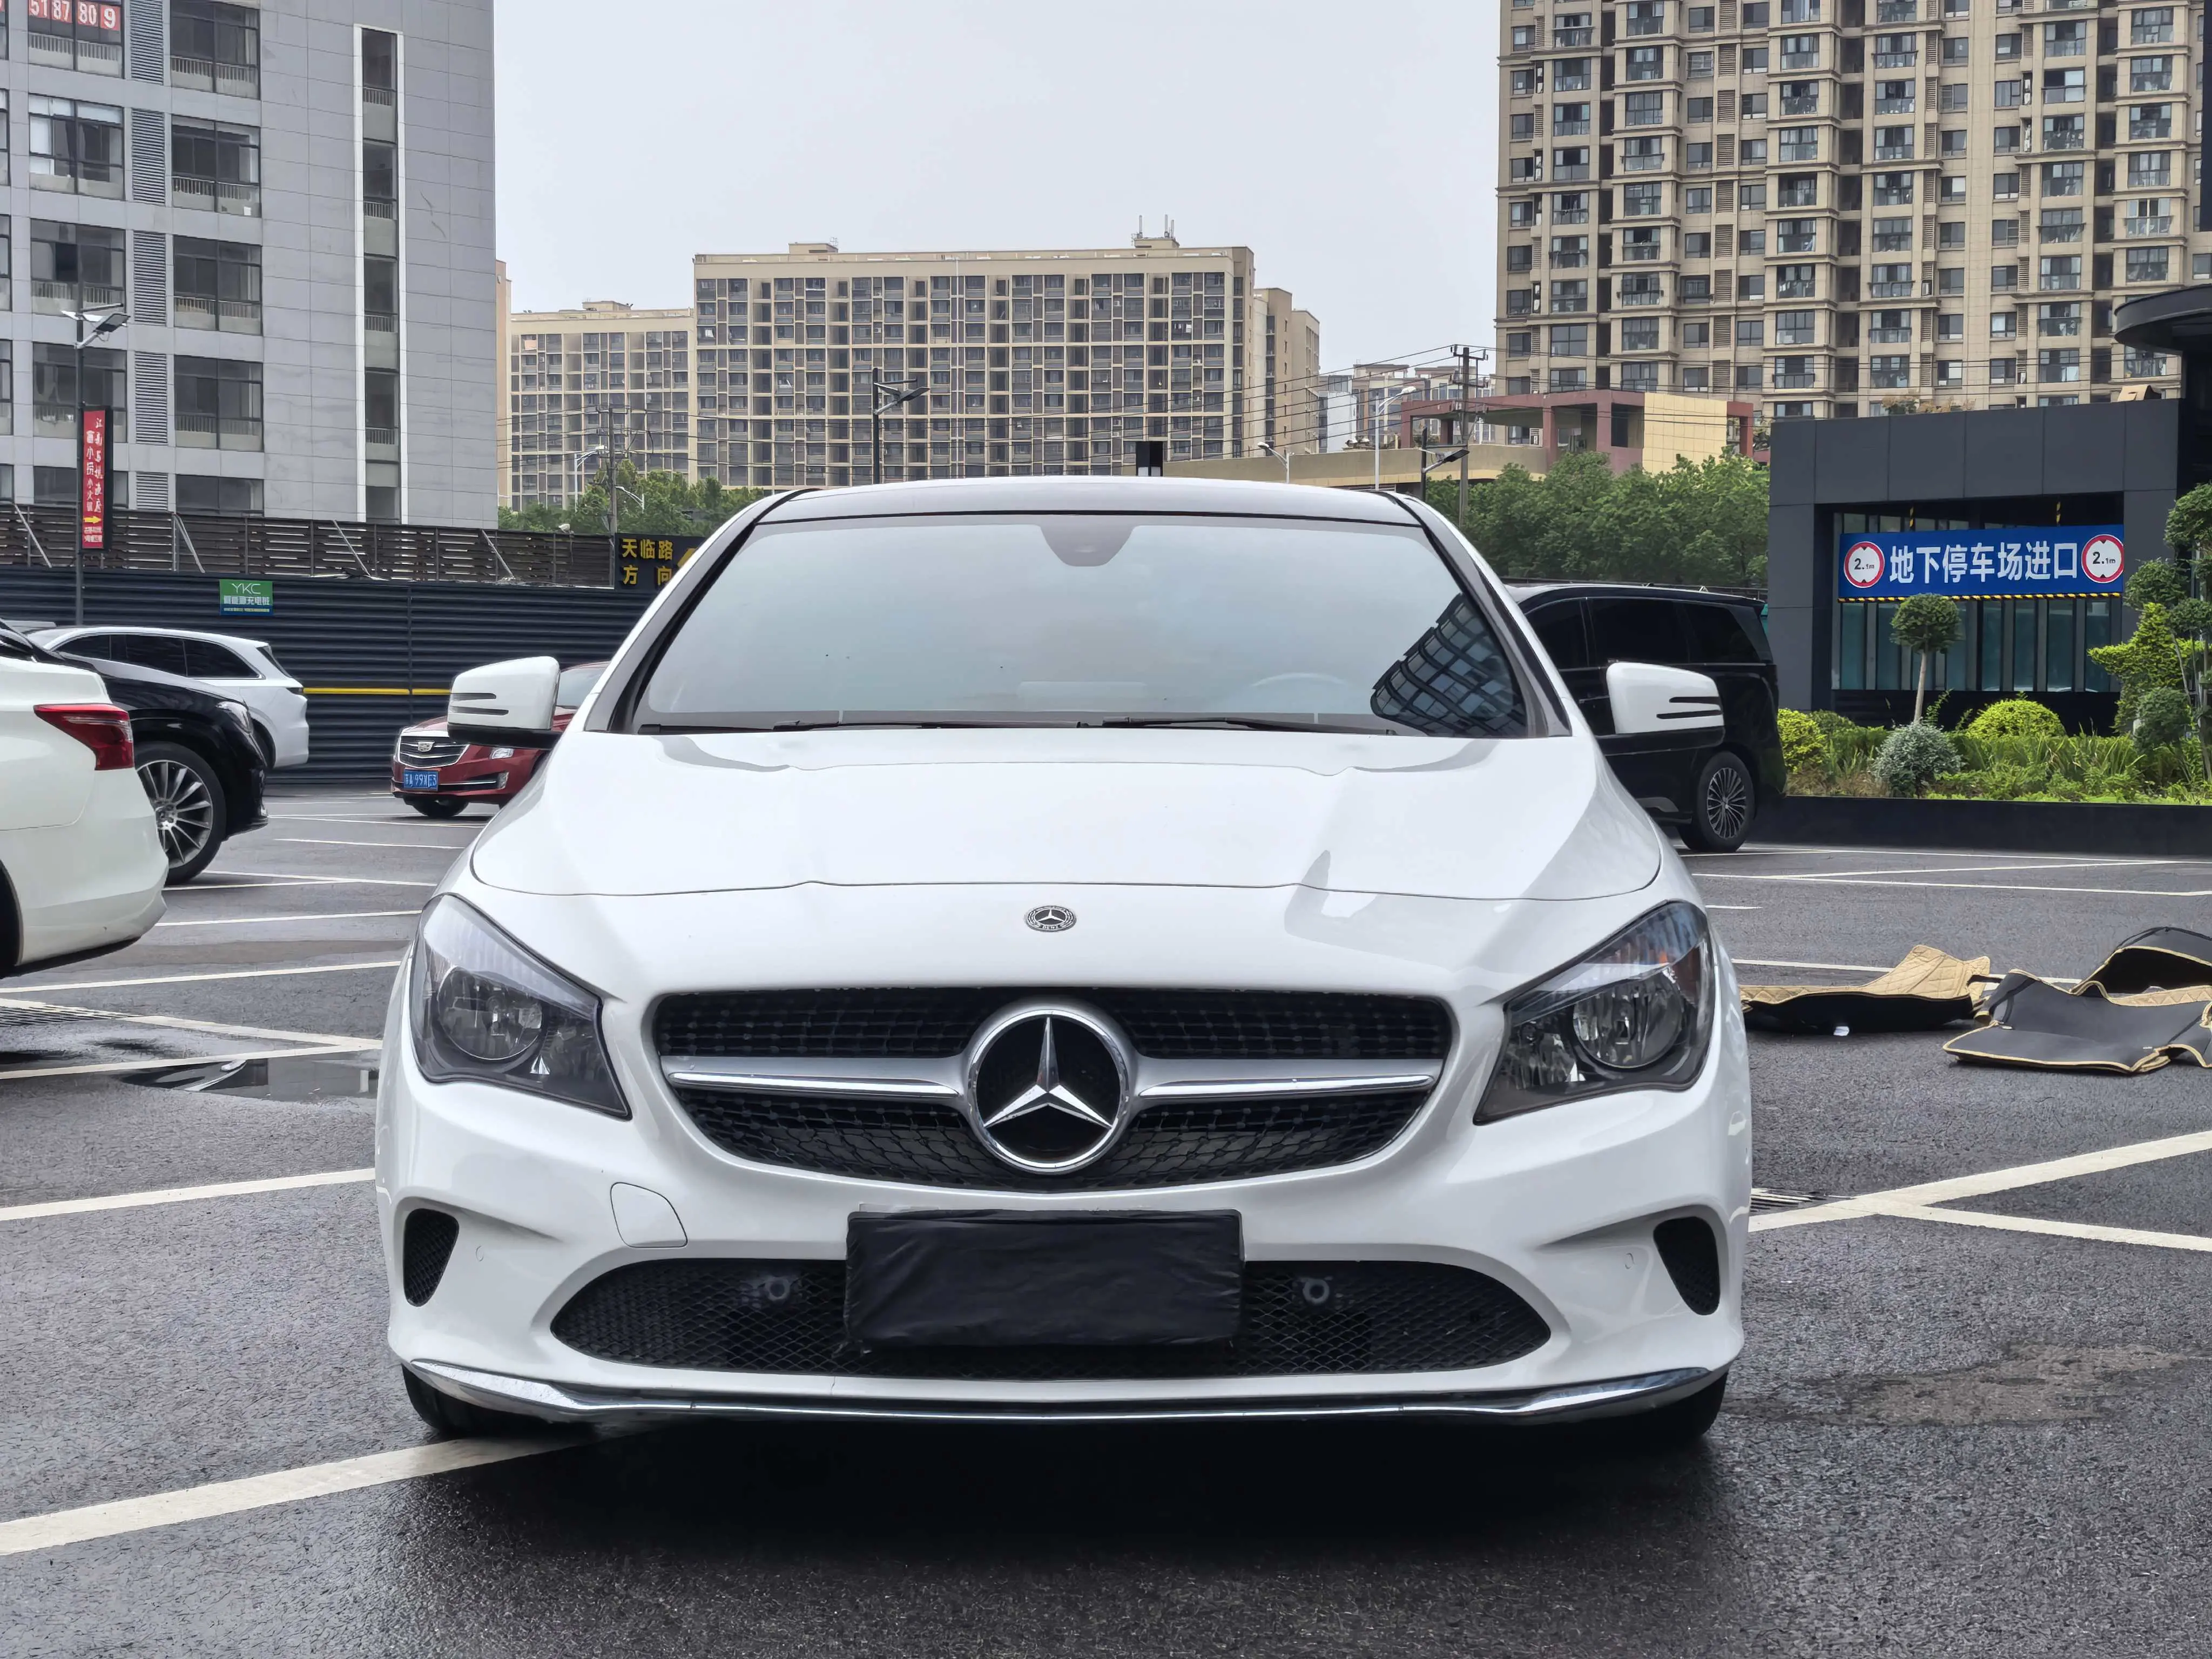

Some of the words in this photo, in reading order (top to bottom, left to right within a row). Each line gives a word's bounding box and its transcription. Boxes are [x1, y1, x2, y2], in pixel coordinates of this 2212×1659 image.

[622, 538, 673, 561] 天临路
[1890, 541, 2078, 584] 地下停车场进口
[623, 565, 672, 585] 方向
[231, 583, 261, 595] YKC
